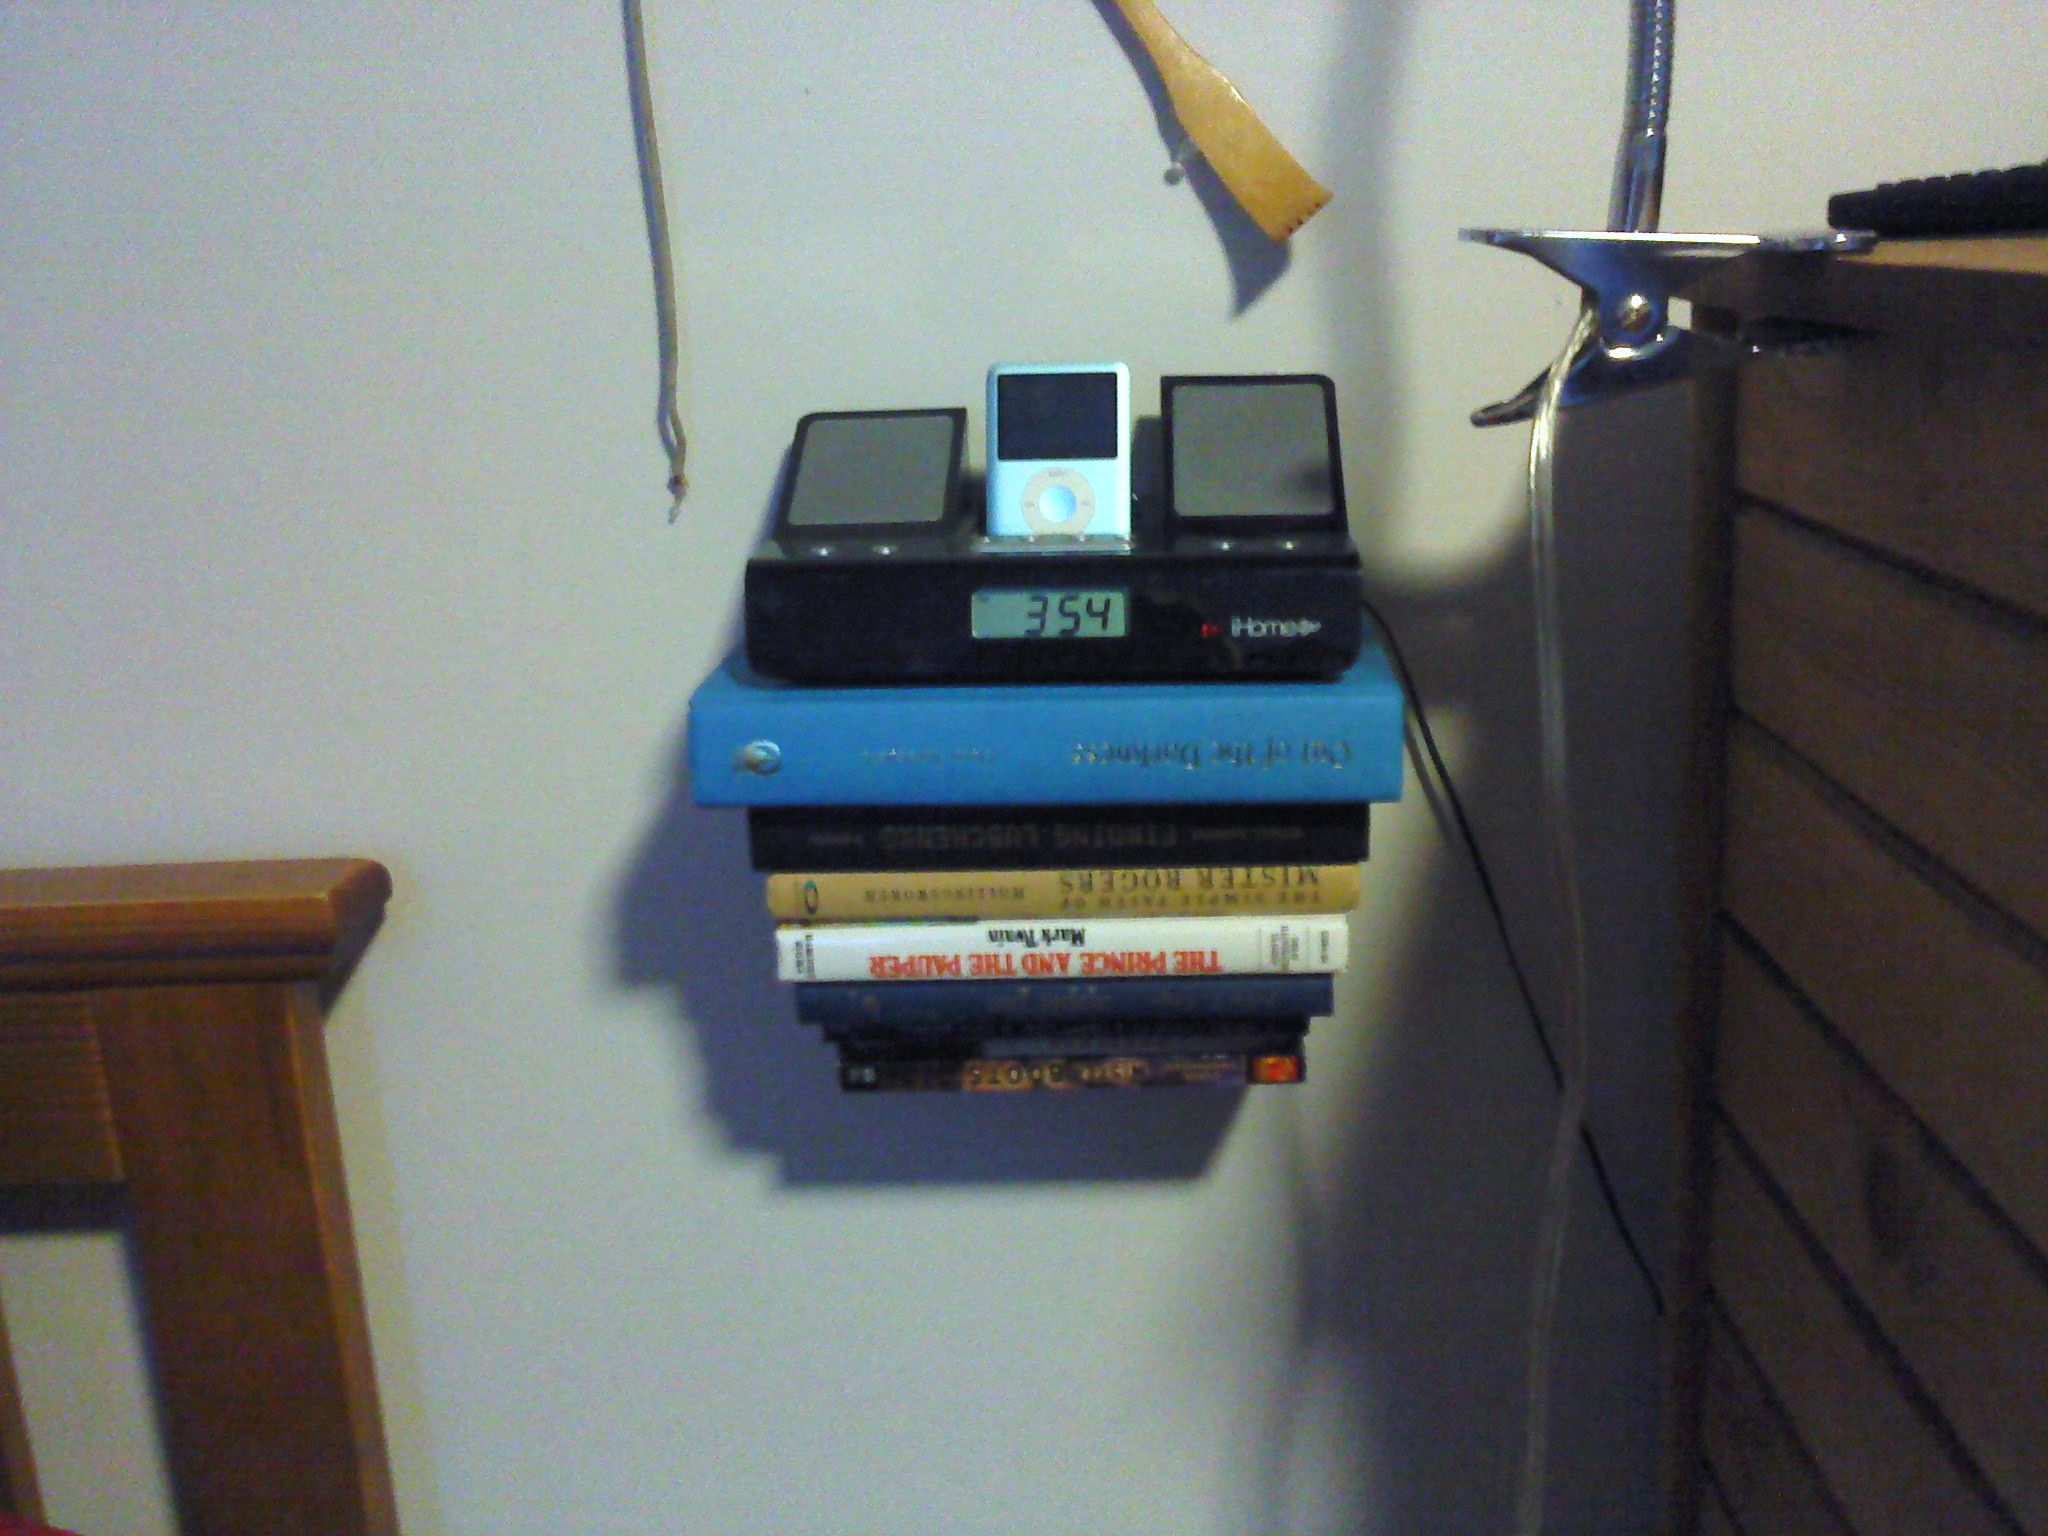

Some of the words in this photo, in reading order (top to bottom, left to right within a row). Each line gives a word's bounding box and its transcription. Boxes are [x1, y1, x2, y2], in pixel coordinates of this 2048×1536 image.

[1231, 616, 1300, 637] iHome
[1072, 743, 1199, 771] Darkness
[1058, 869, 1182, 894] ROGERS
[1196, 867, 1320, 890] MISTER
[987, 928, 1039, 949] Twain
[1041, 928, 1085, 948] Mark
[868, 953, 961, 978] PAUPER
[968, 953, 1017, 976] THE
[1021, 952, 1071, 976] AND
[1079, 950, 1167, 975] PRINCE
[1173, 950, 1222, 974] THE
